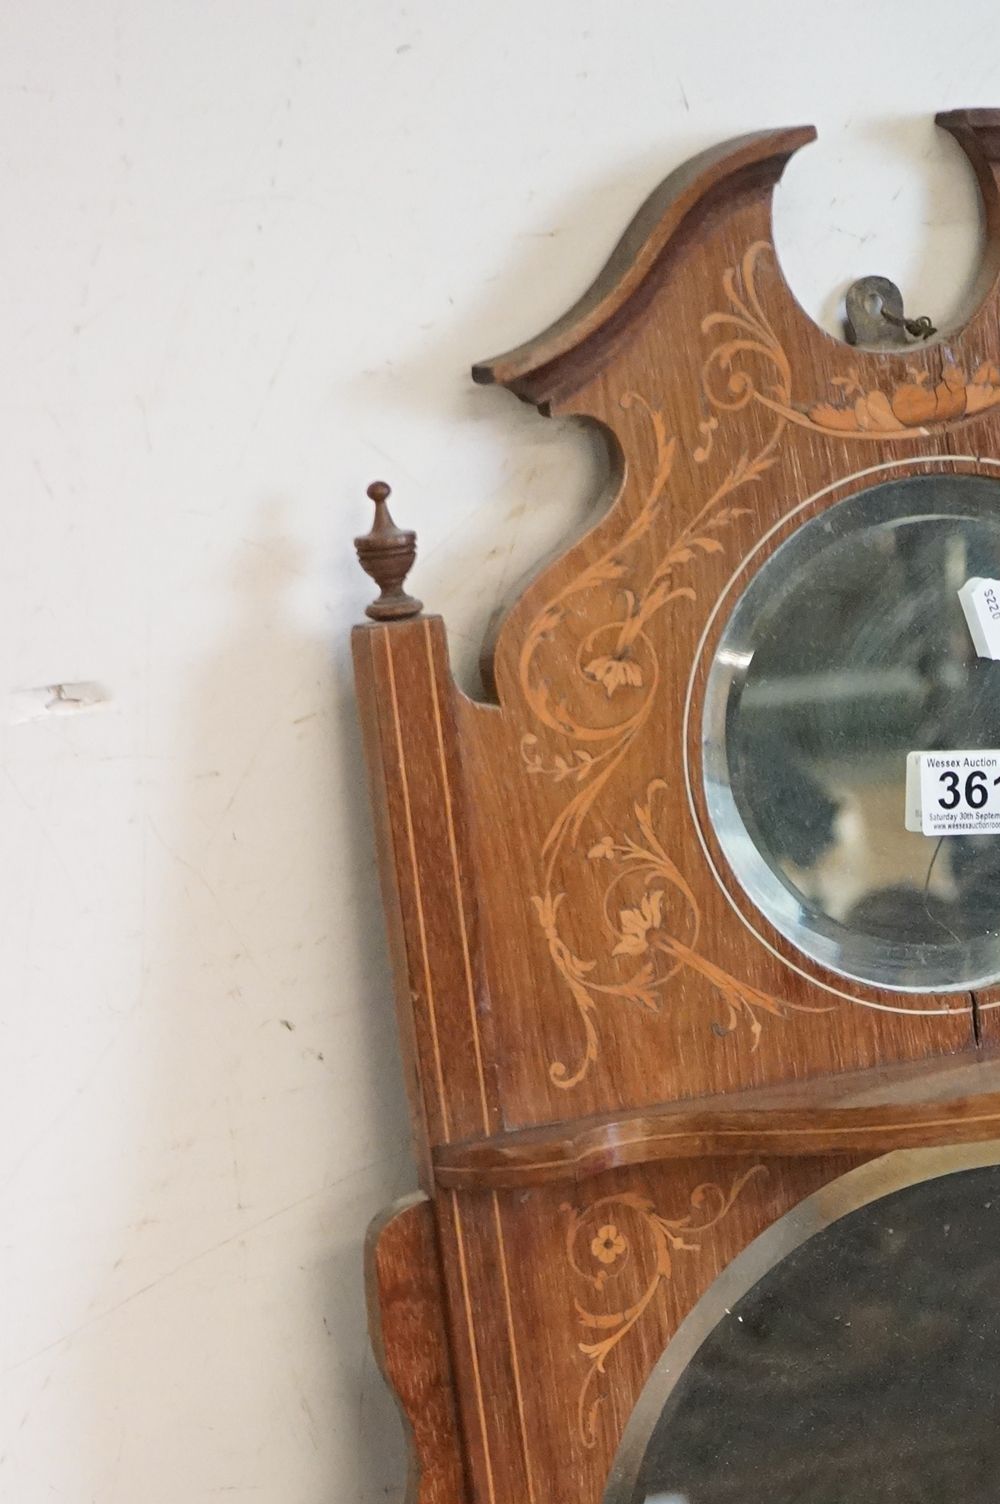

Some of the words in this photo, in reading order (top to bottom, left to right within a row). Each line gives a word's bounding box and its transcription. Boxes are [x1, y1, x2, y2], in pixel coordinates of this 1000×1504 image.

[927, 758, 960, 768] Wessex
[963, 757, 997, 767] Auction
[929, 812, 957, 822] Saturday
[959, 811, 973, 819] 30th
